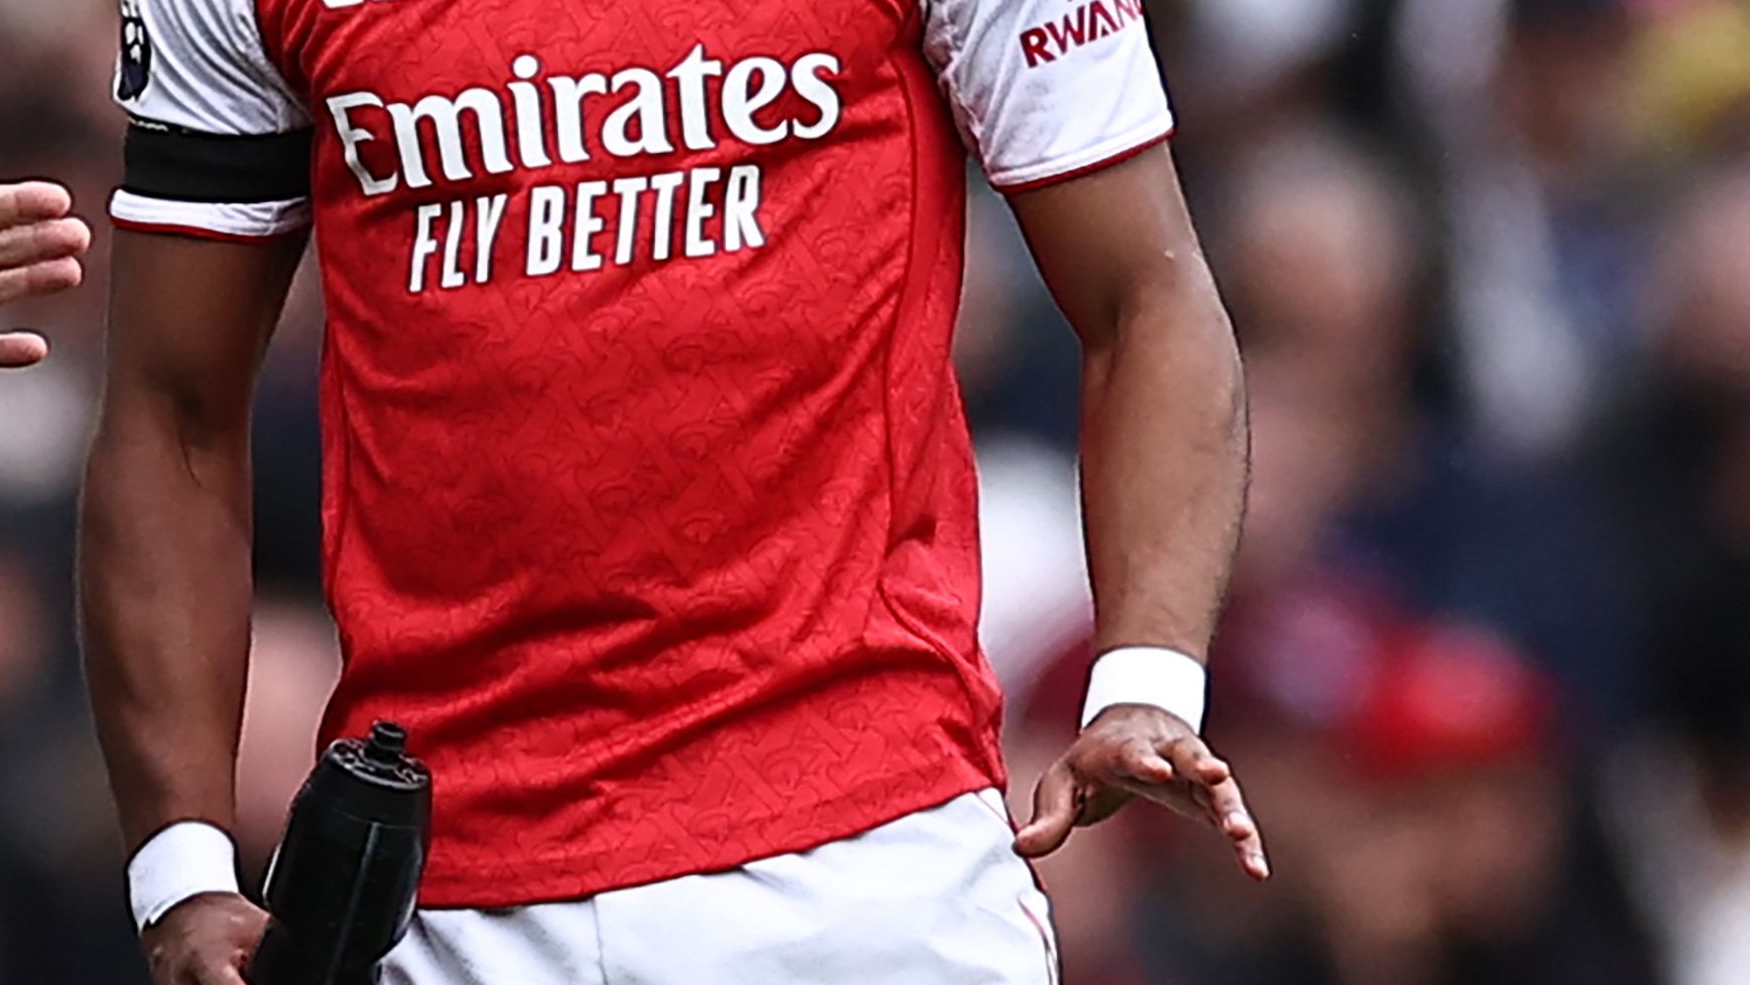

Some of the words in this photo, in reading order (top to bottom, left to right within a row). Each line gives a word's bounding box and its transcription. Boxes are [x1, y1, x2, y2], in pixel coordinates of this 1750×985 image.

[326, 43, 842, 196] Emirates
[409, 195, 507, 293] FLY
[526, 165, 766, 276] BETTER
